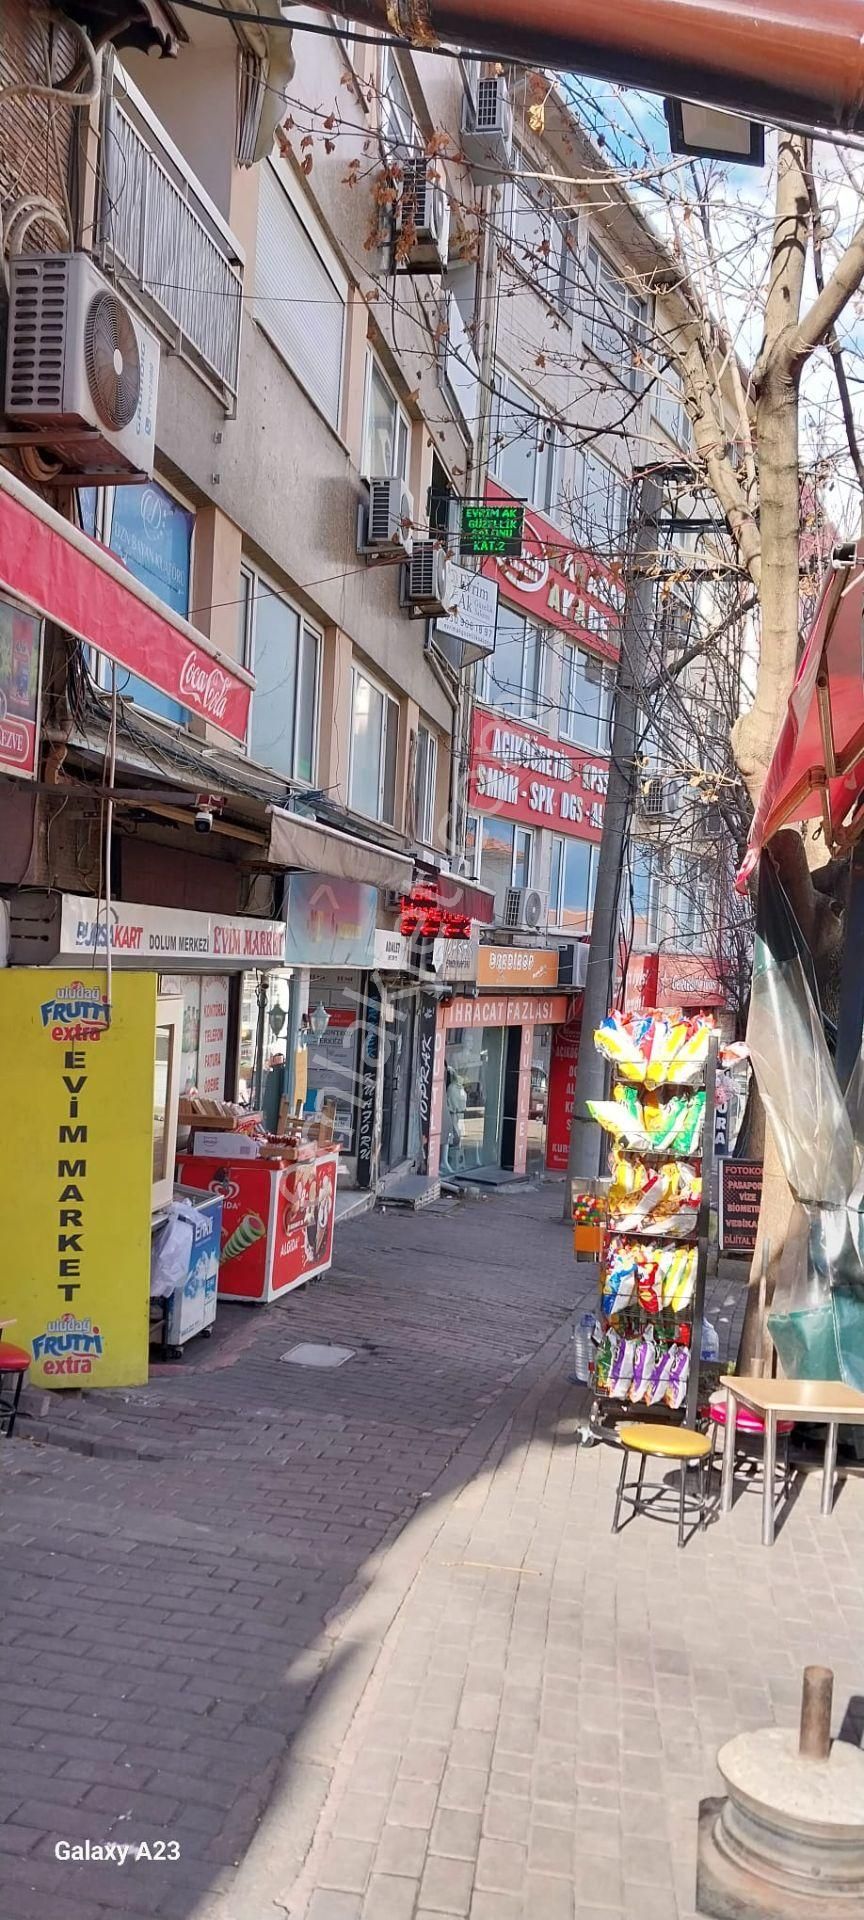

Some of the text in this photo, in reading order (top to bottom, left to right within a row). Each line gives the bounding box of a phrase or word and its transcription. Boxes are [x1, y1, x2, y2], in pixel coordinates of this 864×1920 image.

[502, 508, 517, 518] AK
[473, 541, 505, 552] KAT.2
[529, 781, 554, 815] SPK
[560, 791, 583, 824] DGS
[149, 934, 176, 951] DOLUM
[179, 934, 209, 953] MERKEZİ
[213, 921, 241, 955] EVİM
[507, 1001, 553, 1022] FAZLASI
[52, 1024, 100, 1041] extra
[205, 1028, 223, 1042] TELEFON
[205, 1053, 221, 1068] FATURA
[59, 1051, 88, 1143] EVİM
[518, 1029, 530, 1160] OUTLET
[57, 1159, 87, 1302] MARKET
[46, 1317, 91, 1333] uludağ
[43, 1357, 92, 1376] extra
